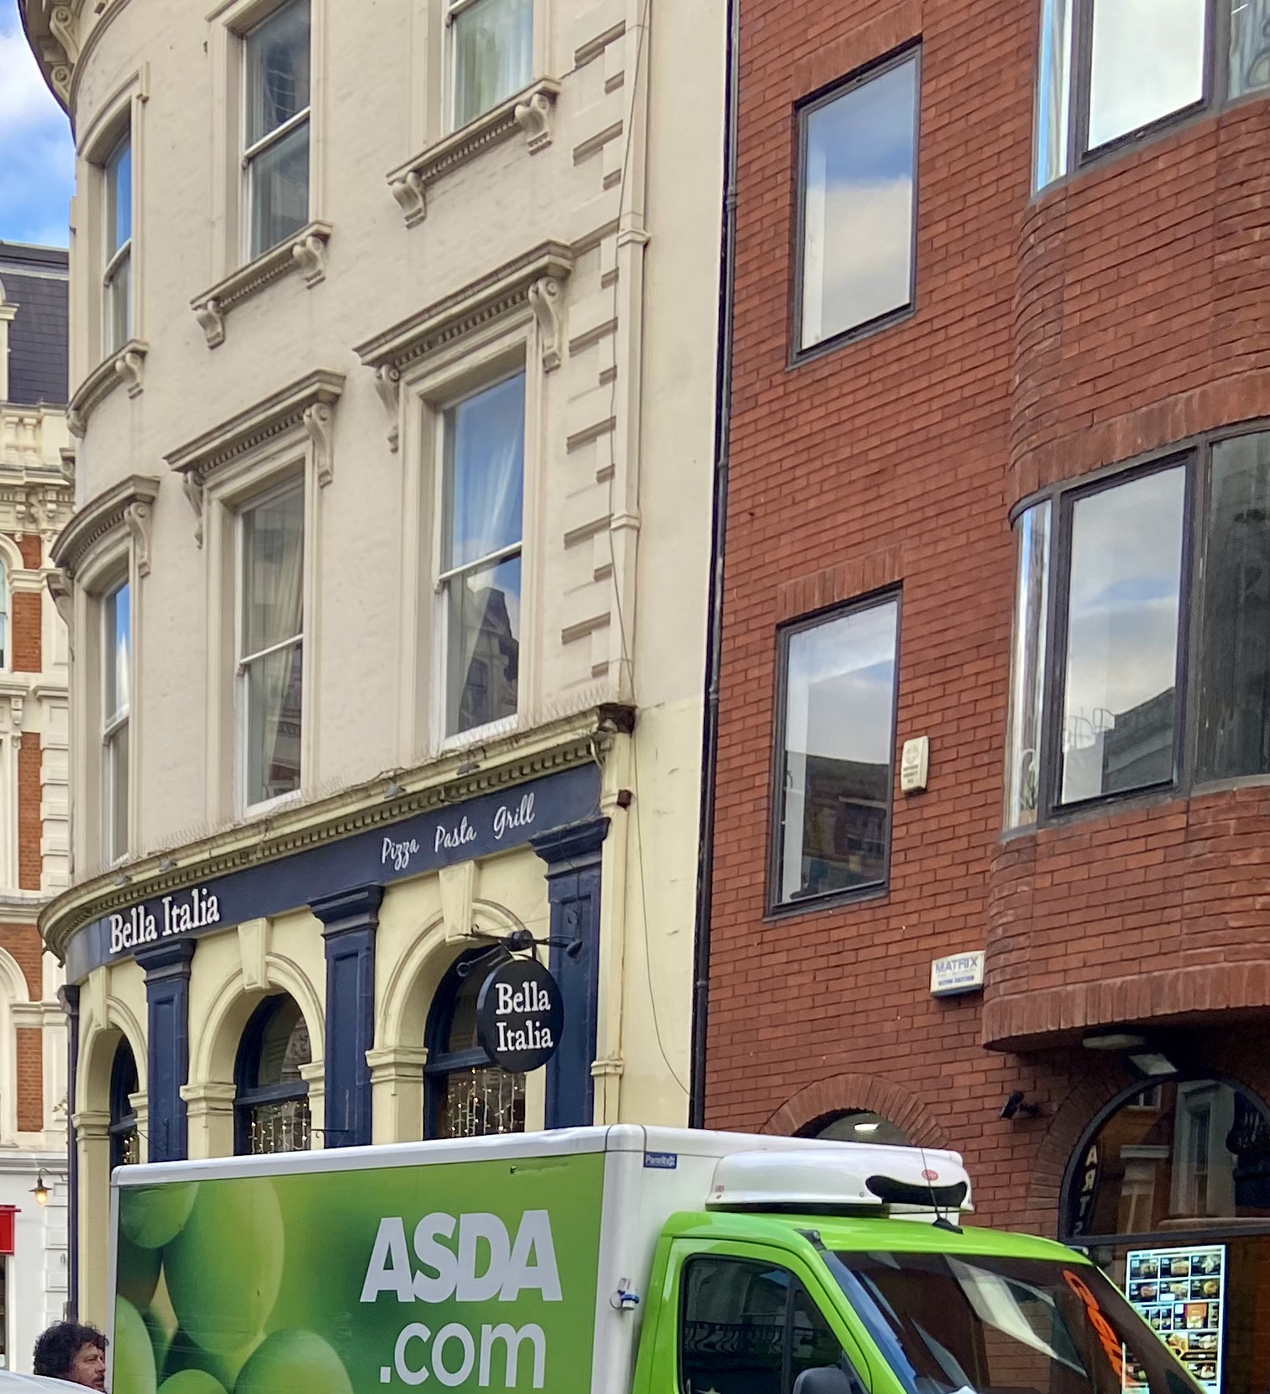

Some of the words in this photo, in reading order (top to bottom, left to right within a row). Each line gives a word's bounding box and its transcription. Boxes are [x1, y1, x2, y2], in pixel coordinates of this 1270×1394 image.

[382, 837, 420, 871] Pizza
[435, 815, 478, 853] Pasta
[493, 792, 536, 840] Grill
[109, 905, 158, 954] Bella
[162, 888, 221, 936] Italia
[495, 980, 552, 1015] Bella
[495, 1019, 554, 1052] Italia
[359, 1209, 563, 1304] ASDA
[380, 1322, 546, 1389] .com
